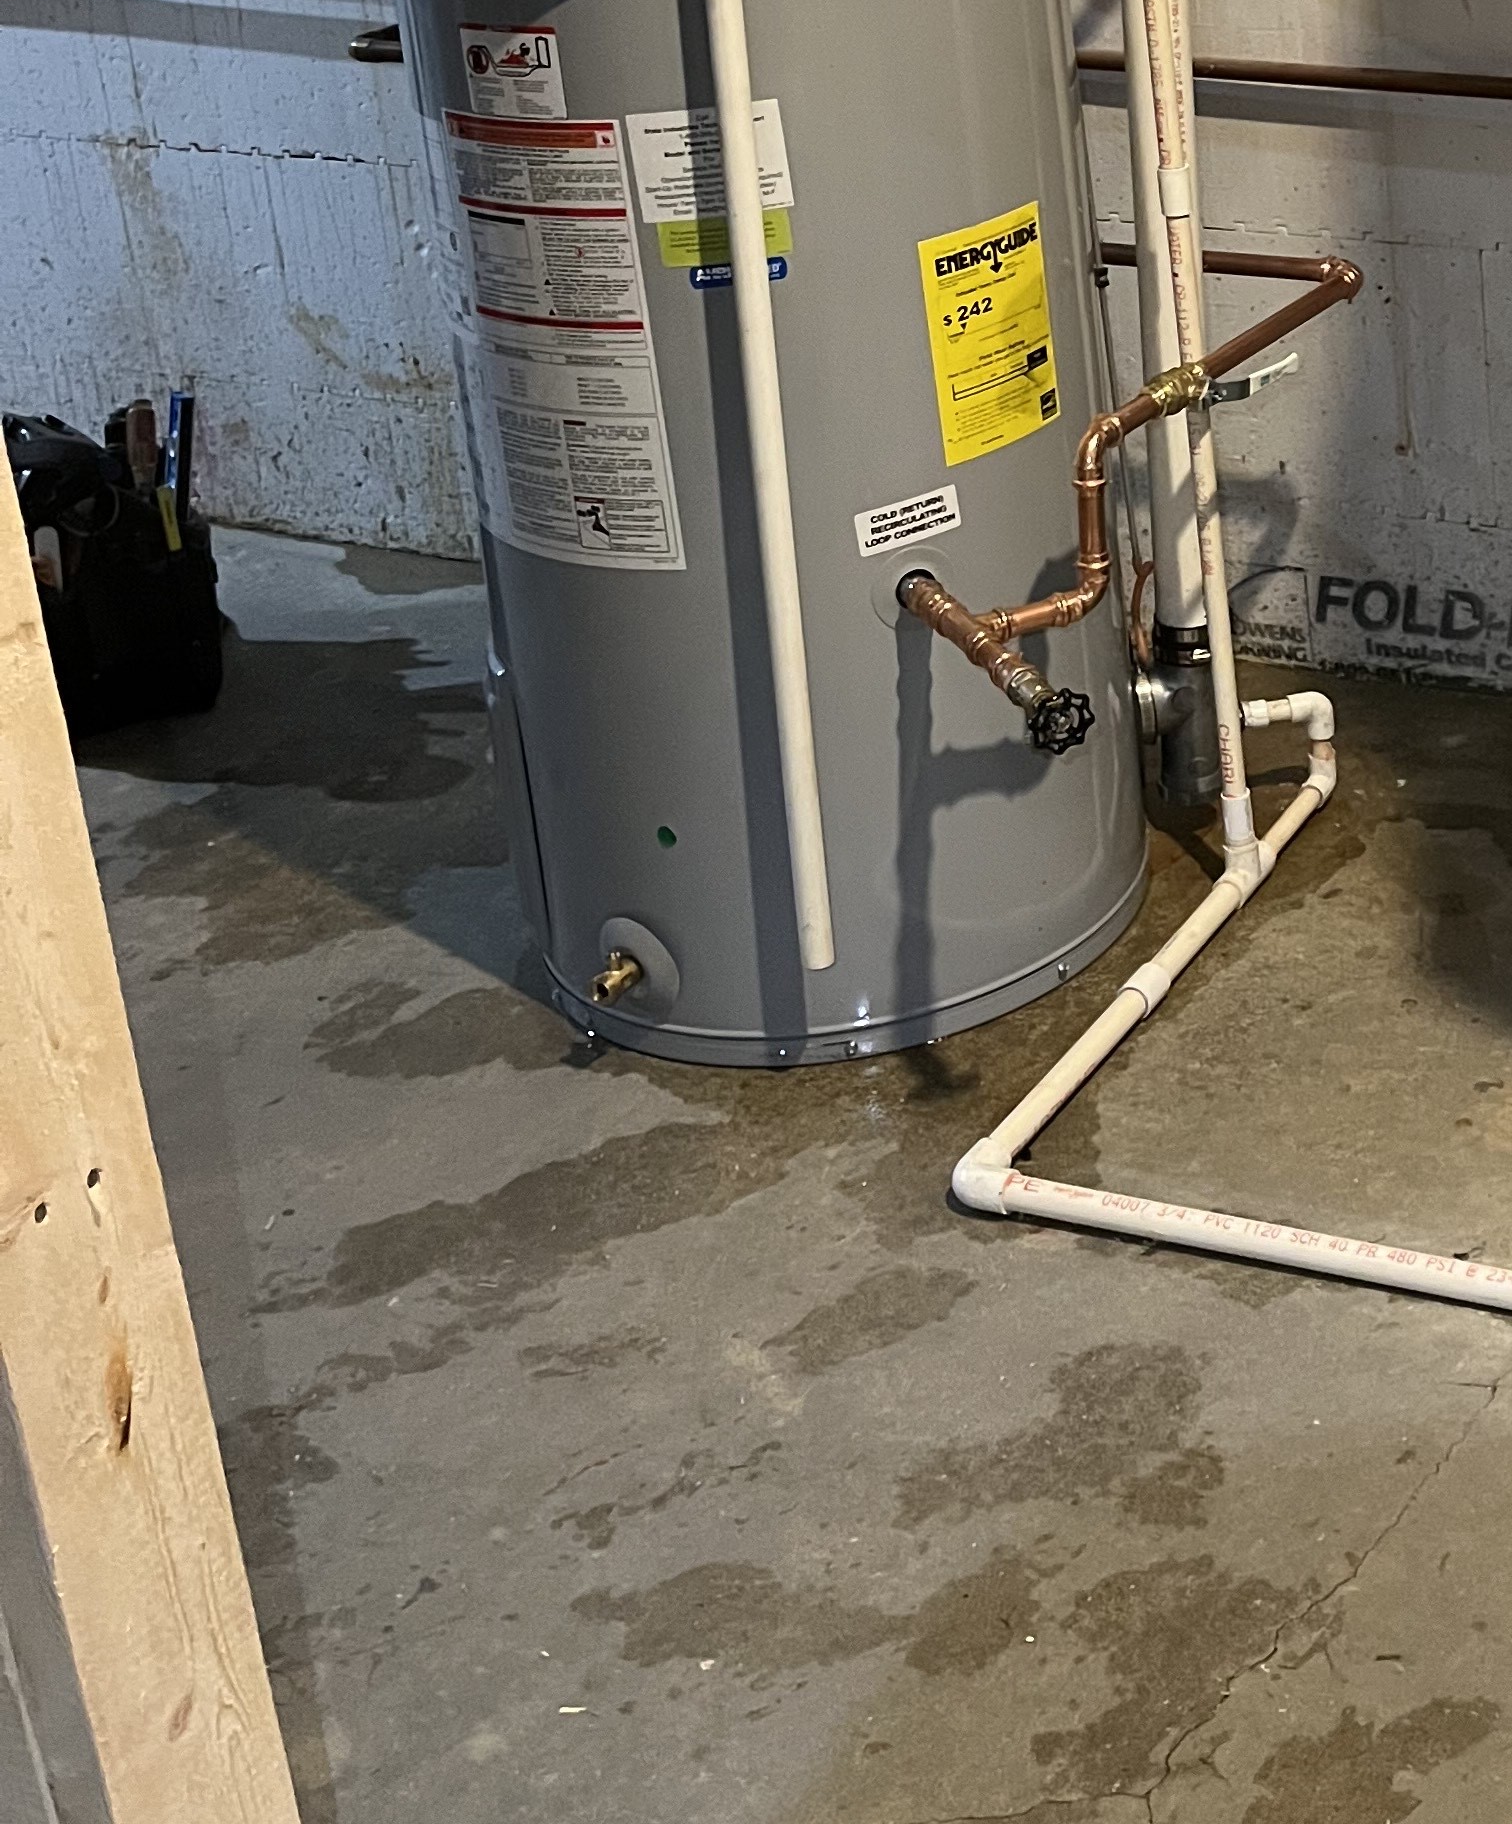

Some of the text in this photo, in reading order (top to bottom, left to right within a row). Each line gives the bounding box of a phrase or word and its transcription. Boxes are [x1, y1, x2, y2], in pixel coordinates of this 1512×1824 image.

[934, 221, 1039, 277] ENERGYGUIDE
[956, 296, 994, 324] 242
[864, 513, 957, 549] LOOP CONNECTION
[870, 509, 898, 524] COLD
[870, 504, 948, 536] RECIRCULATING
[1365, 637, 1487, 669] Insulated
[1101, 1194, 1150, 1212] 04007
[1203, 1214, 1234, 1230] PVC
[1242, 1221, 1283, 1240] 1120
[1289, 1232, 1320, 1248] SCH
[1328, 1239, 1348, 1252] 40
[1355, 1244, 1378, 1258] PR
[1386, 1249, 1418, 1266] 480
[1425, 1257, 1456, 1274] PSI
